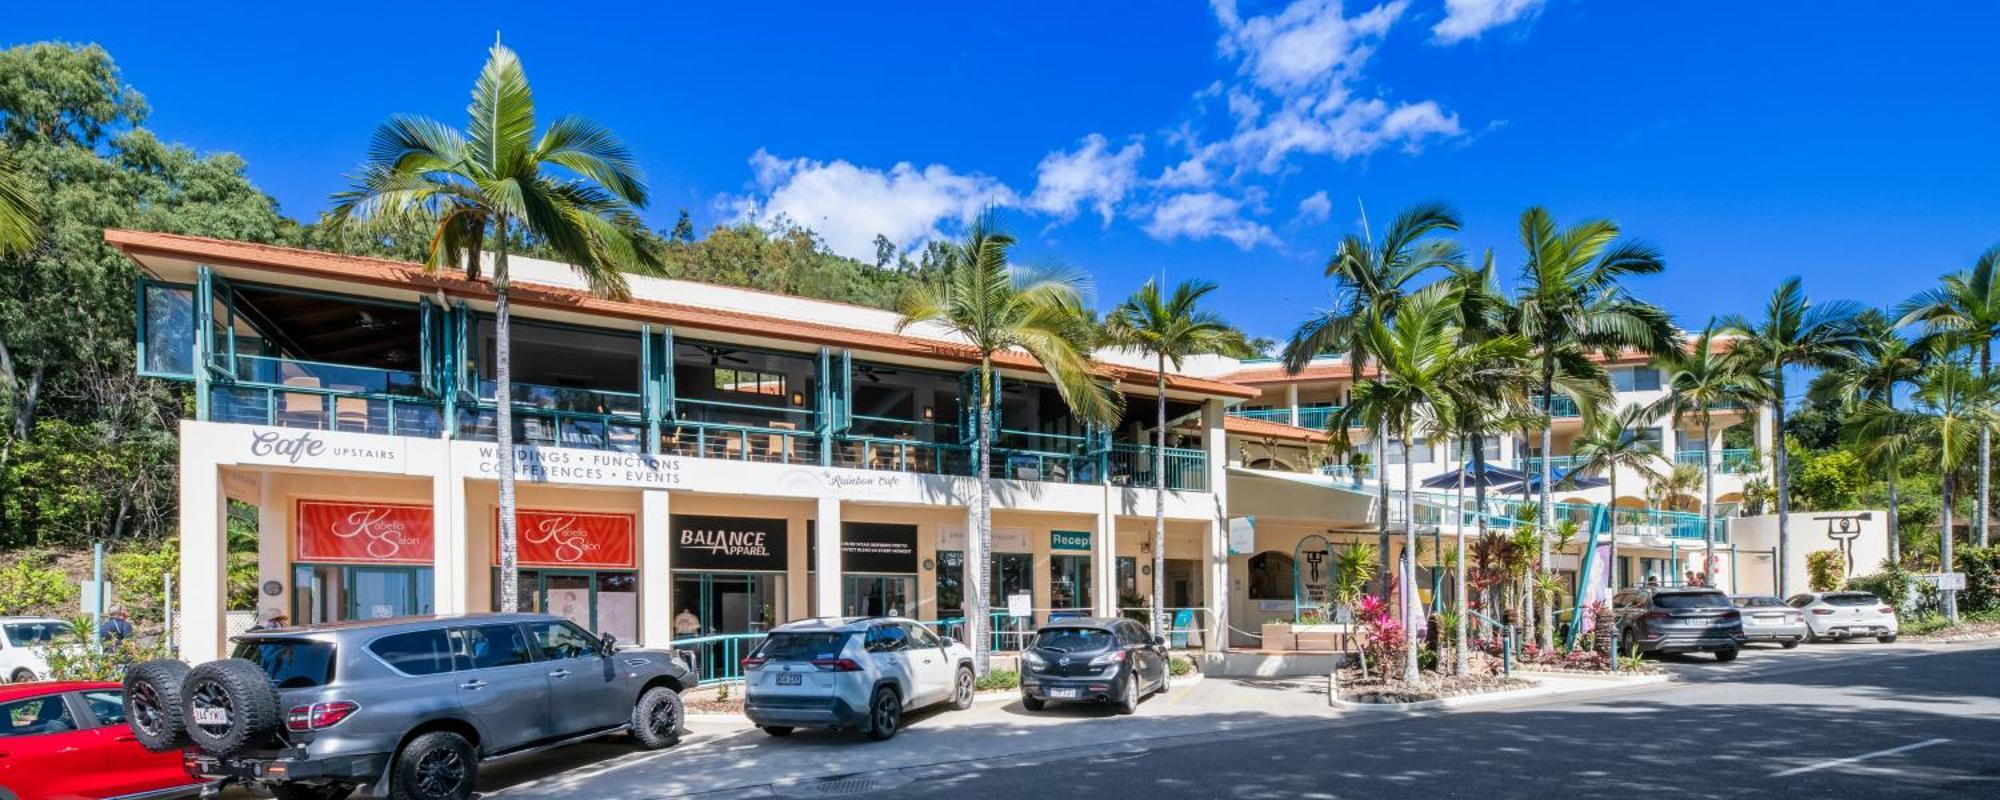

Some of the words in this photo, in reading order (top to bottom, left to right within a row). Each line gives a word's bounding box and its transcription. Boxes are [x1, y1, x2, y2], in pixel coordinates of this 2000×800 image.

[251, 429, 327, 464] Cafe
[333, 447, 395, 460] UPSTAIRS
[479, 447, 570, 463] WEDINGS
[593, 455, 680, 471] FUNCTIONS
[626, 471, 680, 484] EVENTS
[830, 474, 873, 489] Rainbow
[680, 529, 766, 555] BALANCE
[1053, 534, 1091, 548] Recep
